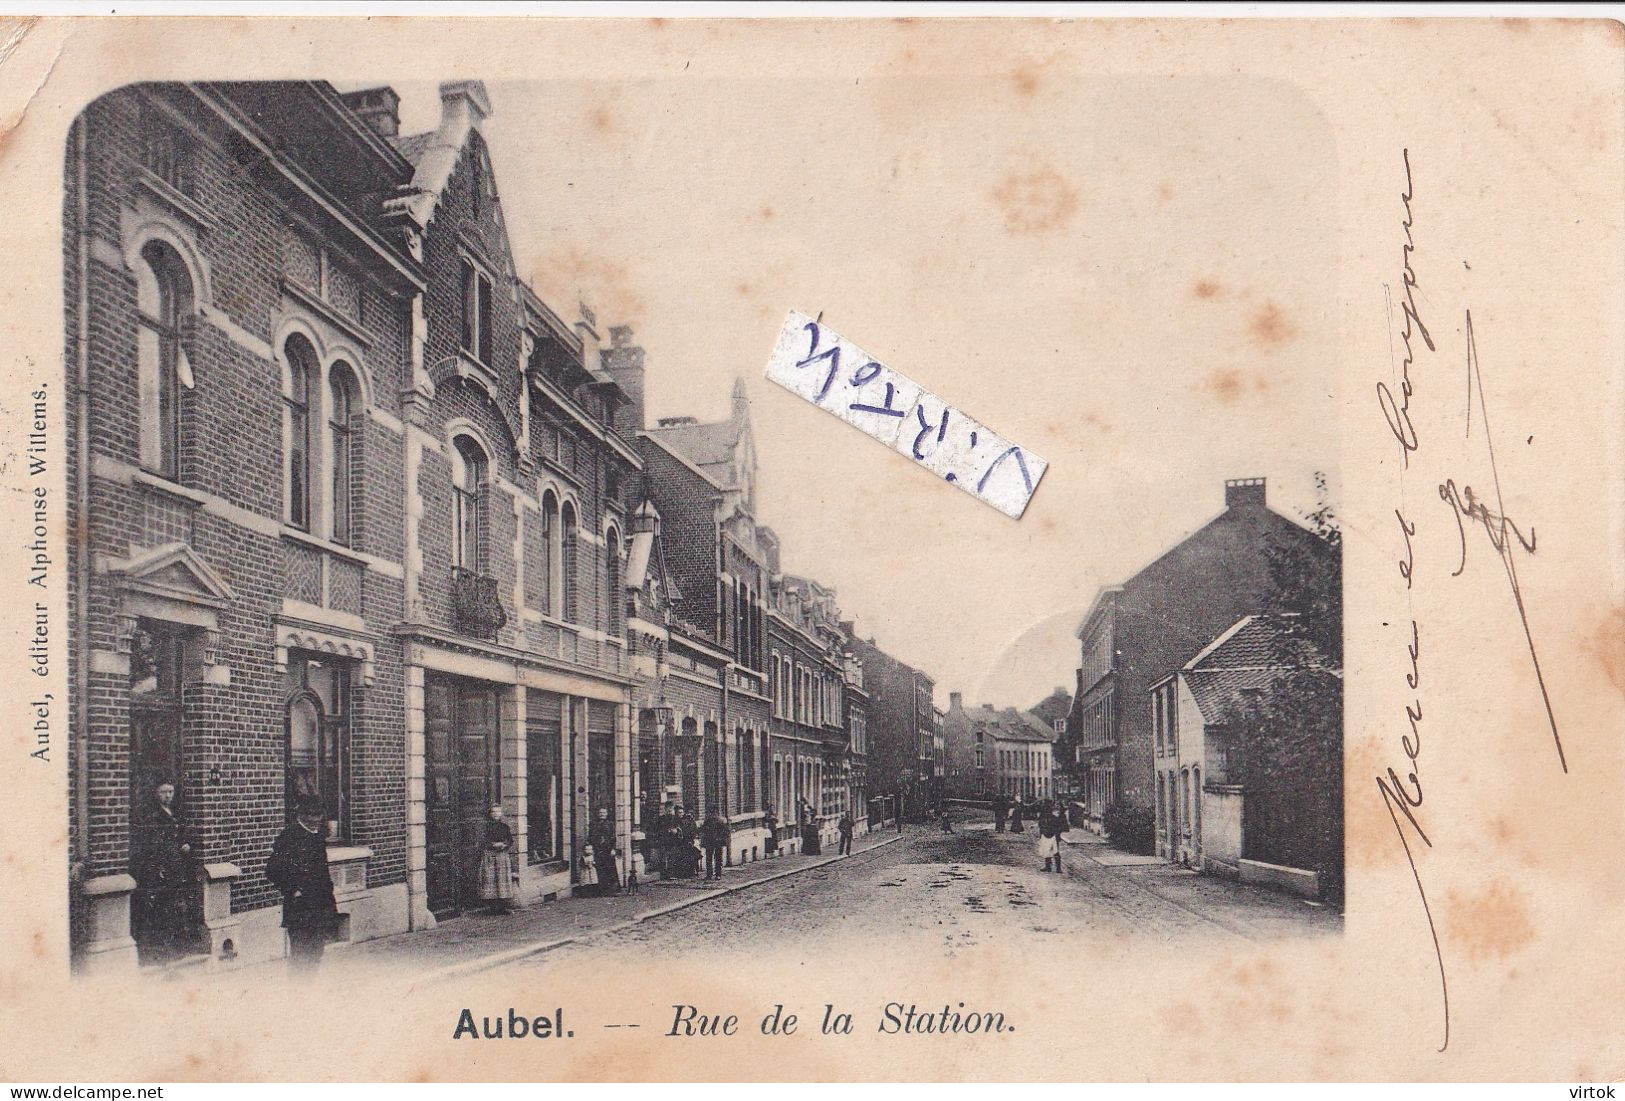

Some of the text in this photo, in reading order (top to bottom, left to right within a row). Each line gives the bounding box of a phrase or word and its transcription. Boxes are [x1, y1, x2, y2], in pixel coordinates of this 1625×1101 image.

[26, 383, 54, 763] Aubel, éditeur Alphonse Willems.
[1395, 509, 1416, 590] et
[453, 1007, 575, 1040] Aubel.
[664, 1005, 739, 1036] Rue
[760, 1004, 798, 1036] de
[821, 1004, 853, 1035] la
[877, 1002, 1017, 1034] Station.
